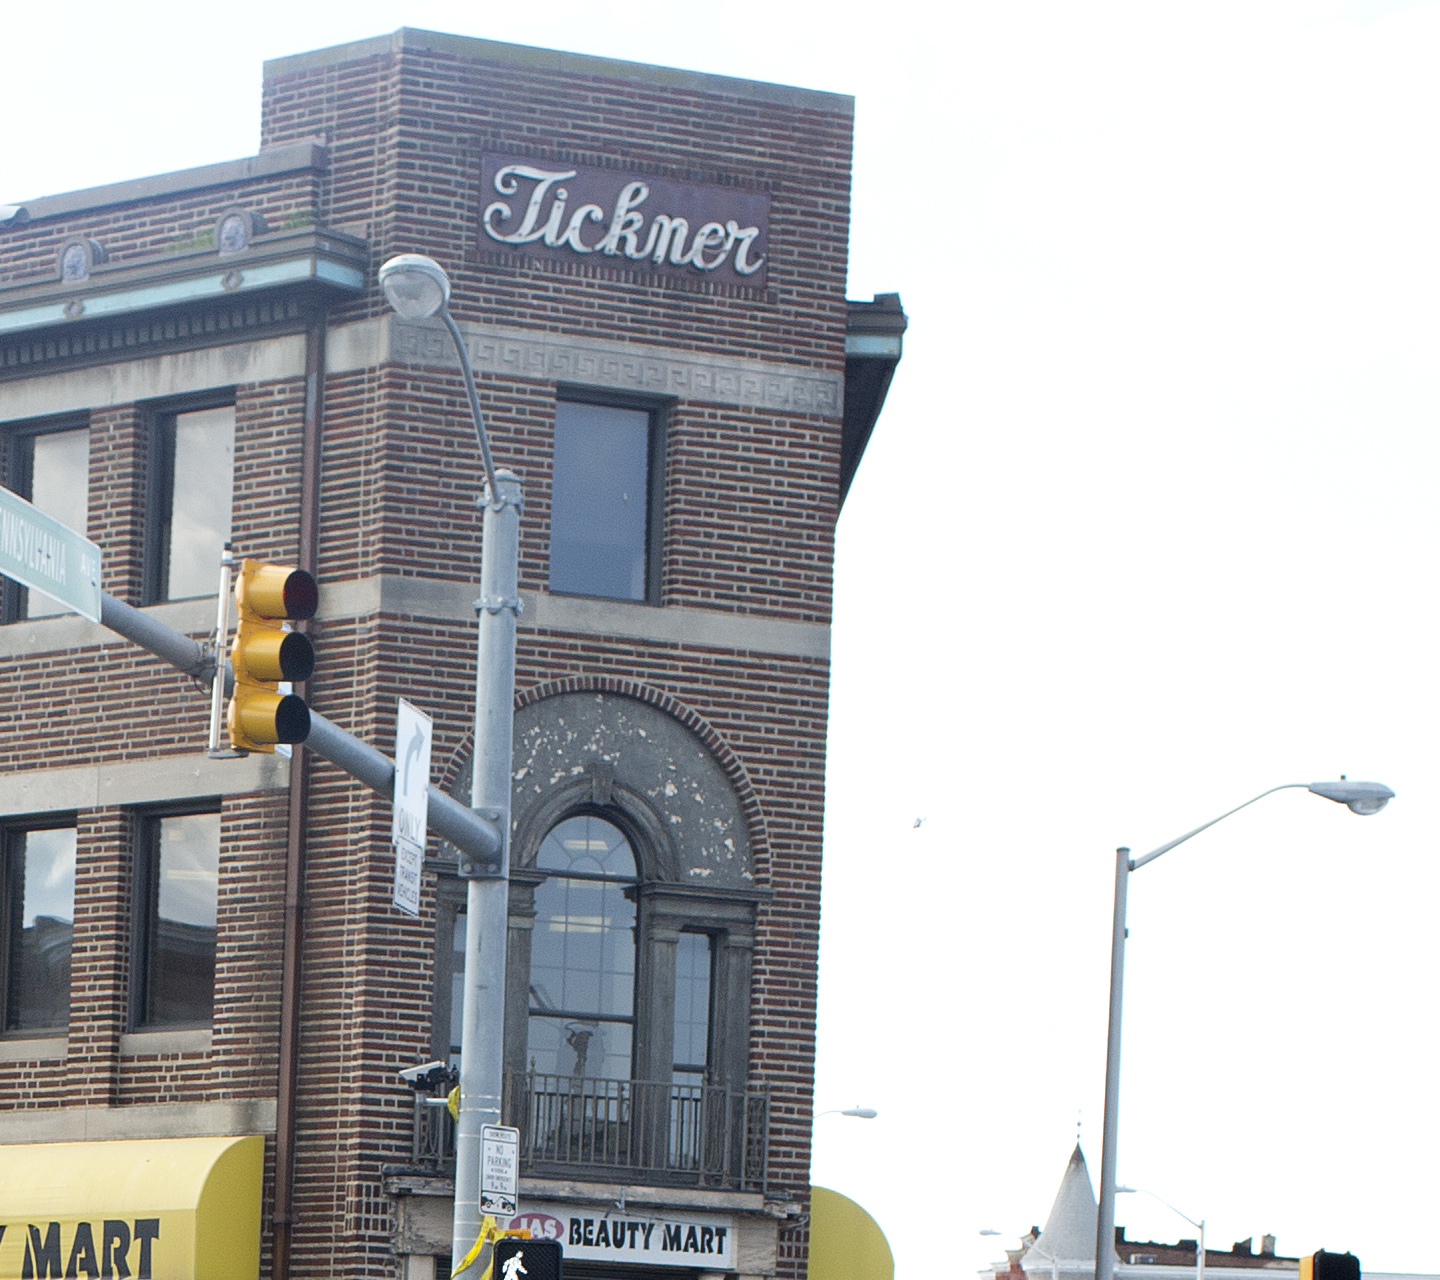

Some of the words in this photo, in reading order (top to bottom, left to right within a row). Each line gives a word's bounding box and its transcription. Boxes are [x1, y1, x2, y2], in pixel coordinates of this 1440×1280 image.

[483, 164, 766, 275] Tickner
[569, 1217, 655, 1250] BEAUTY
[662, 1223, 727, 1255] MART
